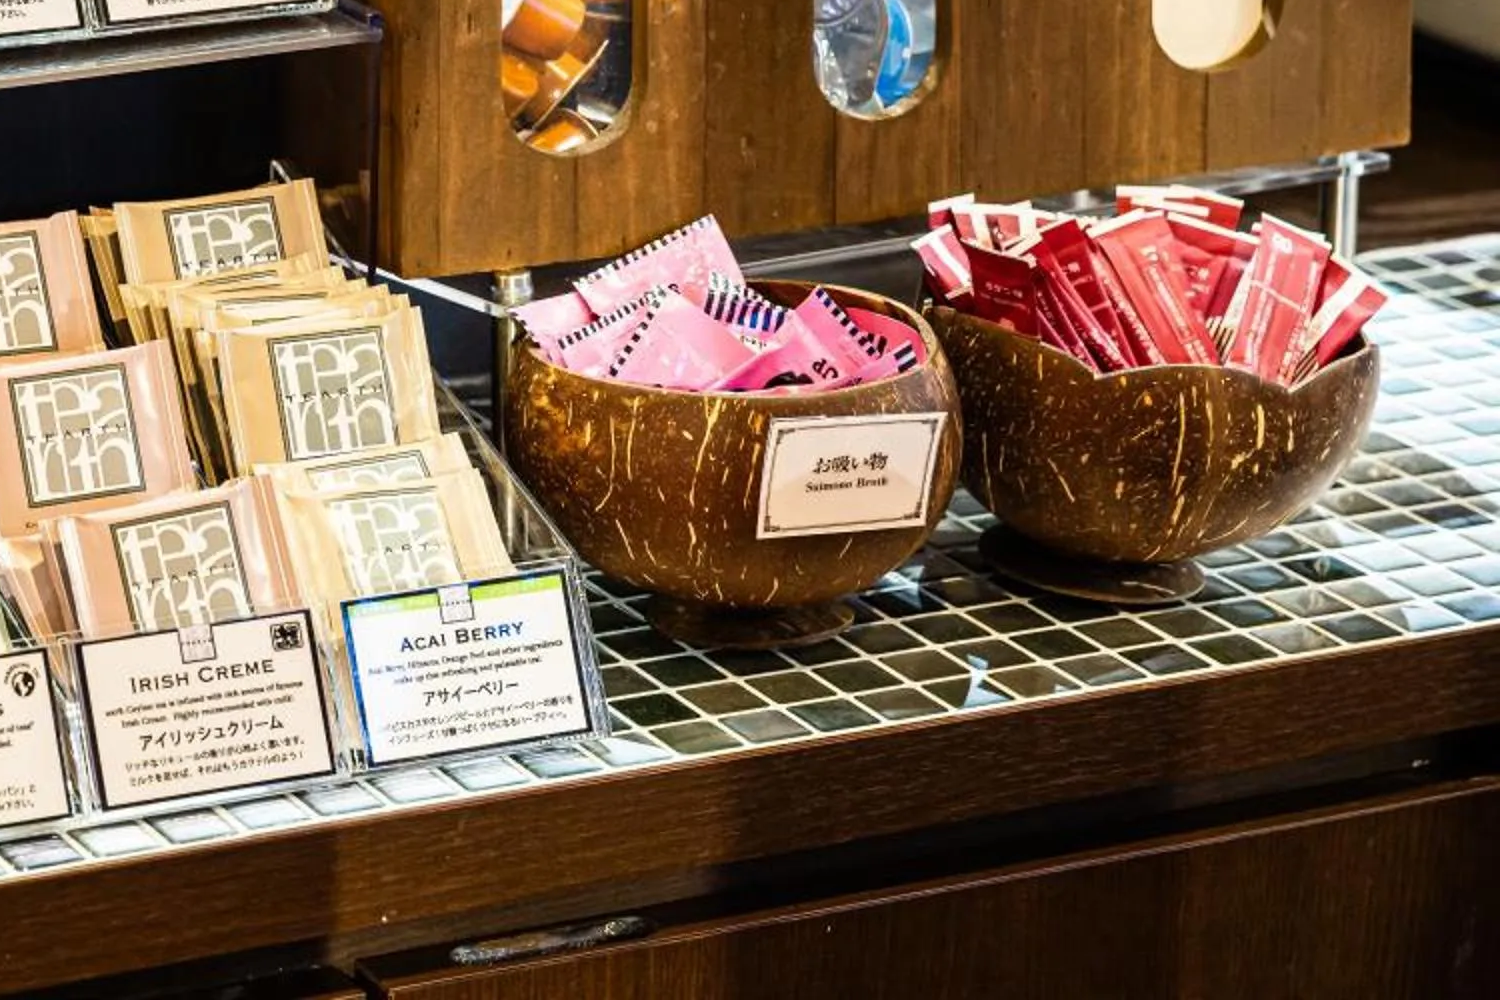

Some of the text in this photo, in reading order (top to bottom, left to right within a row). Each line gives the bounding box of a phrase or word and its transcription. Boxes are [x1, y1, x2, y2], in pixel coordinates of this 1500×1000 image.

[812, 451, 889, 474] お吸い物
[399, 619, 526, 653] ACAI BERRY
[129, 668, 190, 695] IRISH
[196, 655, 275, 684] CREME
[422, 676, 521, 707] アサイーベリー
[137, 712, 284, 752] アイリッシュクリーム
